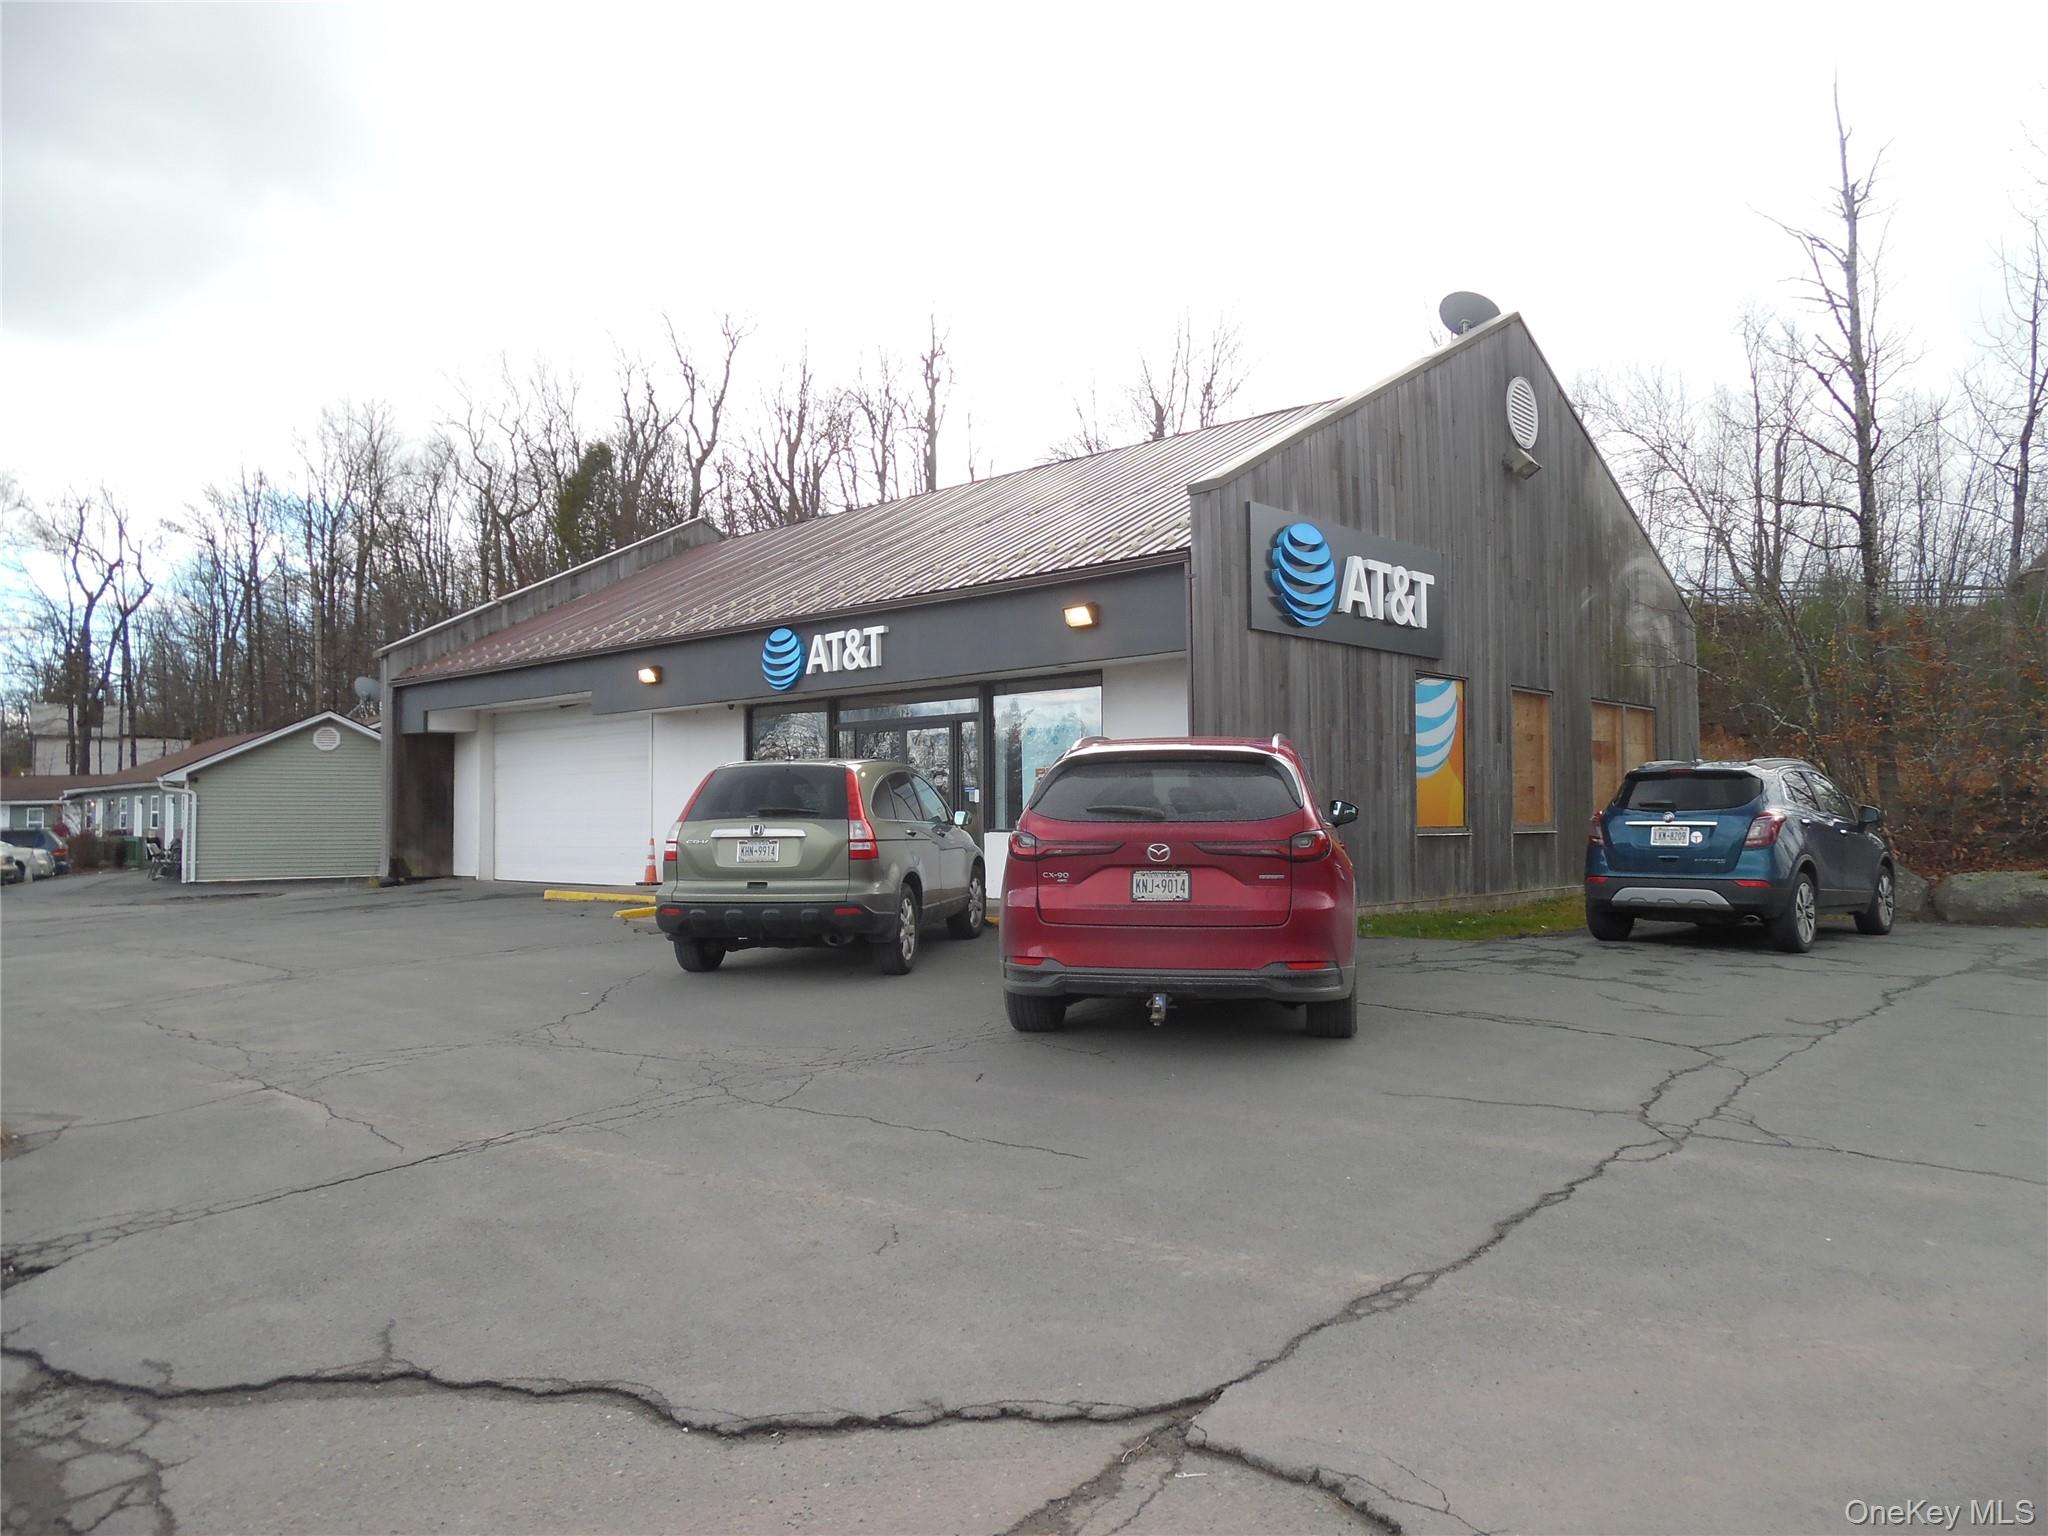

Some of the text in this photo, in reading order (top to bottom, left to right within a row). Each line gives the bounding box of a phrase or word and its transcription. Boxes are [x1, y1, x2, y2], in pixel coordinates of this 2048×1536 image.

[1337, 555, 1435, 629] AT&T
[805, 625, 889, 674] AT&T
[1135, 878, 1186, 894] KNJ-9014
